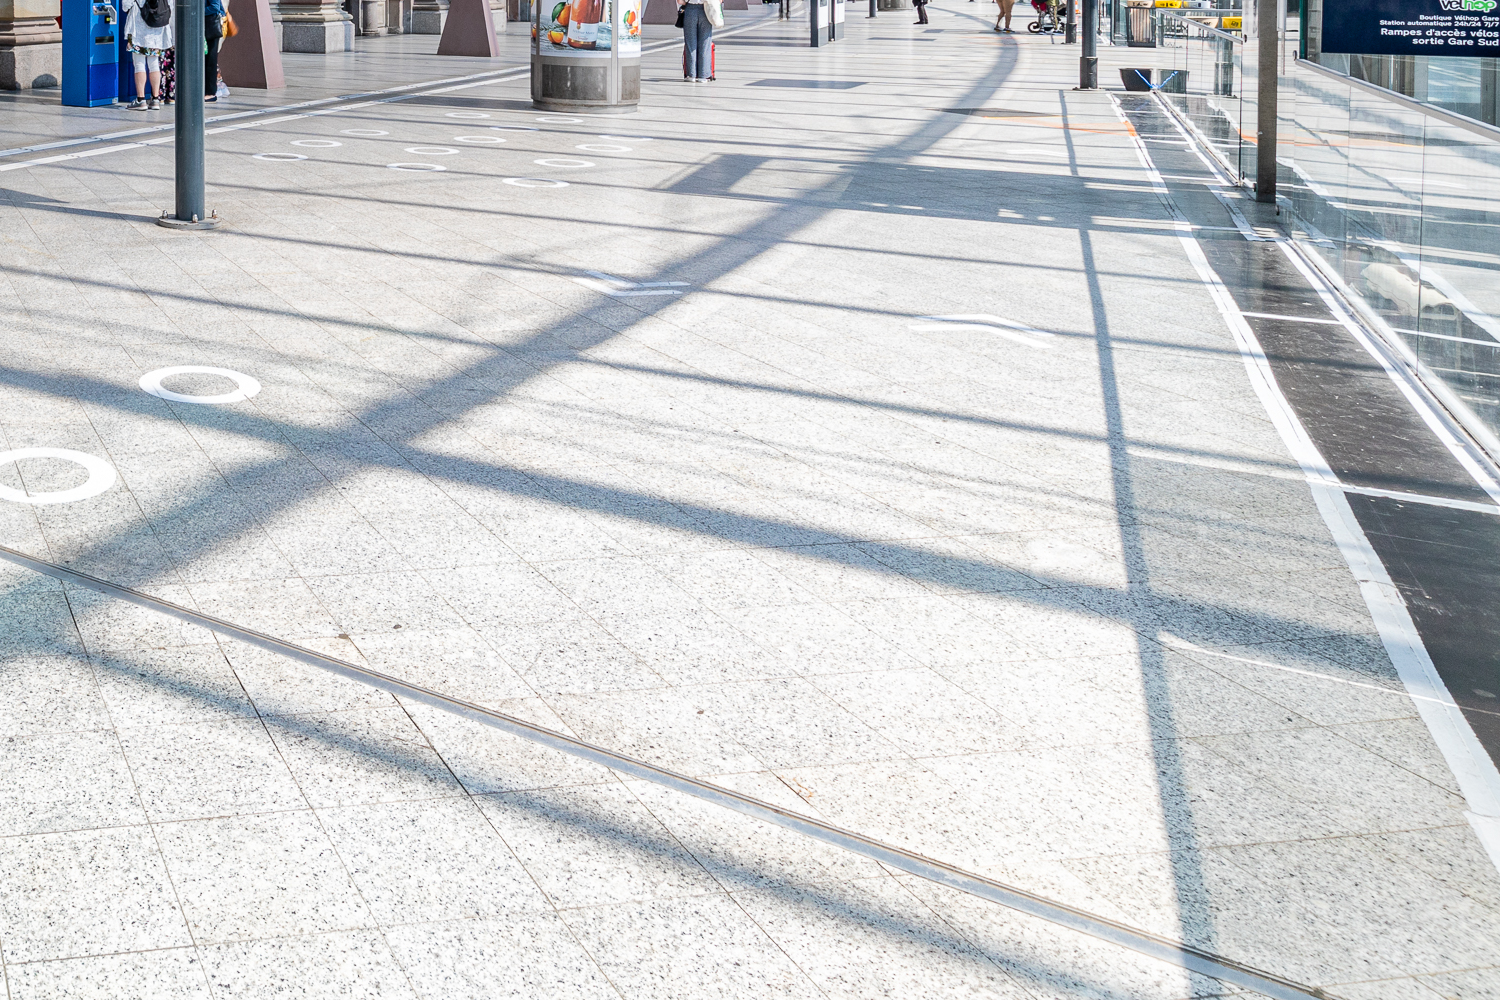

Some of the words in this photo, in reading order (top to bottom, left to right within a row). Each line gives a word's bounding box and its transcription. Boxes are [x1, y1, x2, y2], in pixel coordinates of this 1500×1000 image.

[1380, 28, 1422, 36] Rampes
[1426, 28, 1466, 37] d'accès
[1470, 29, 1499, 37] vélos
